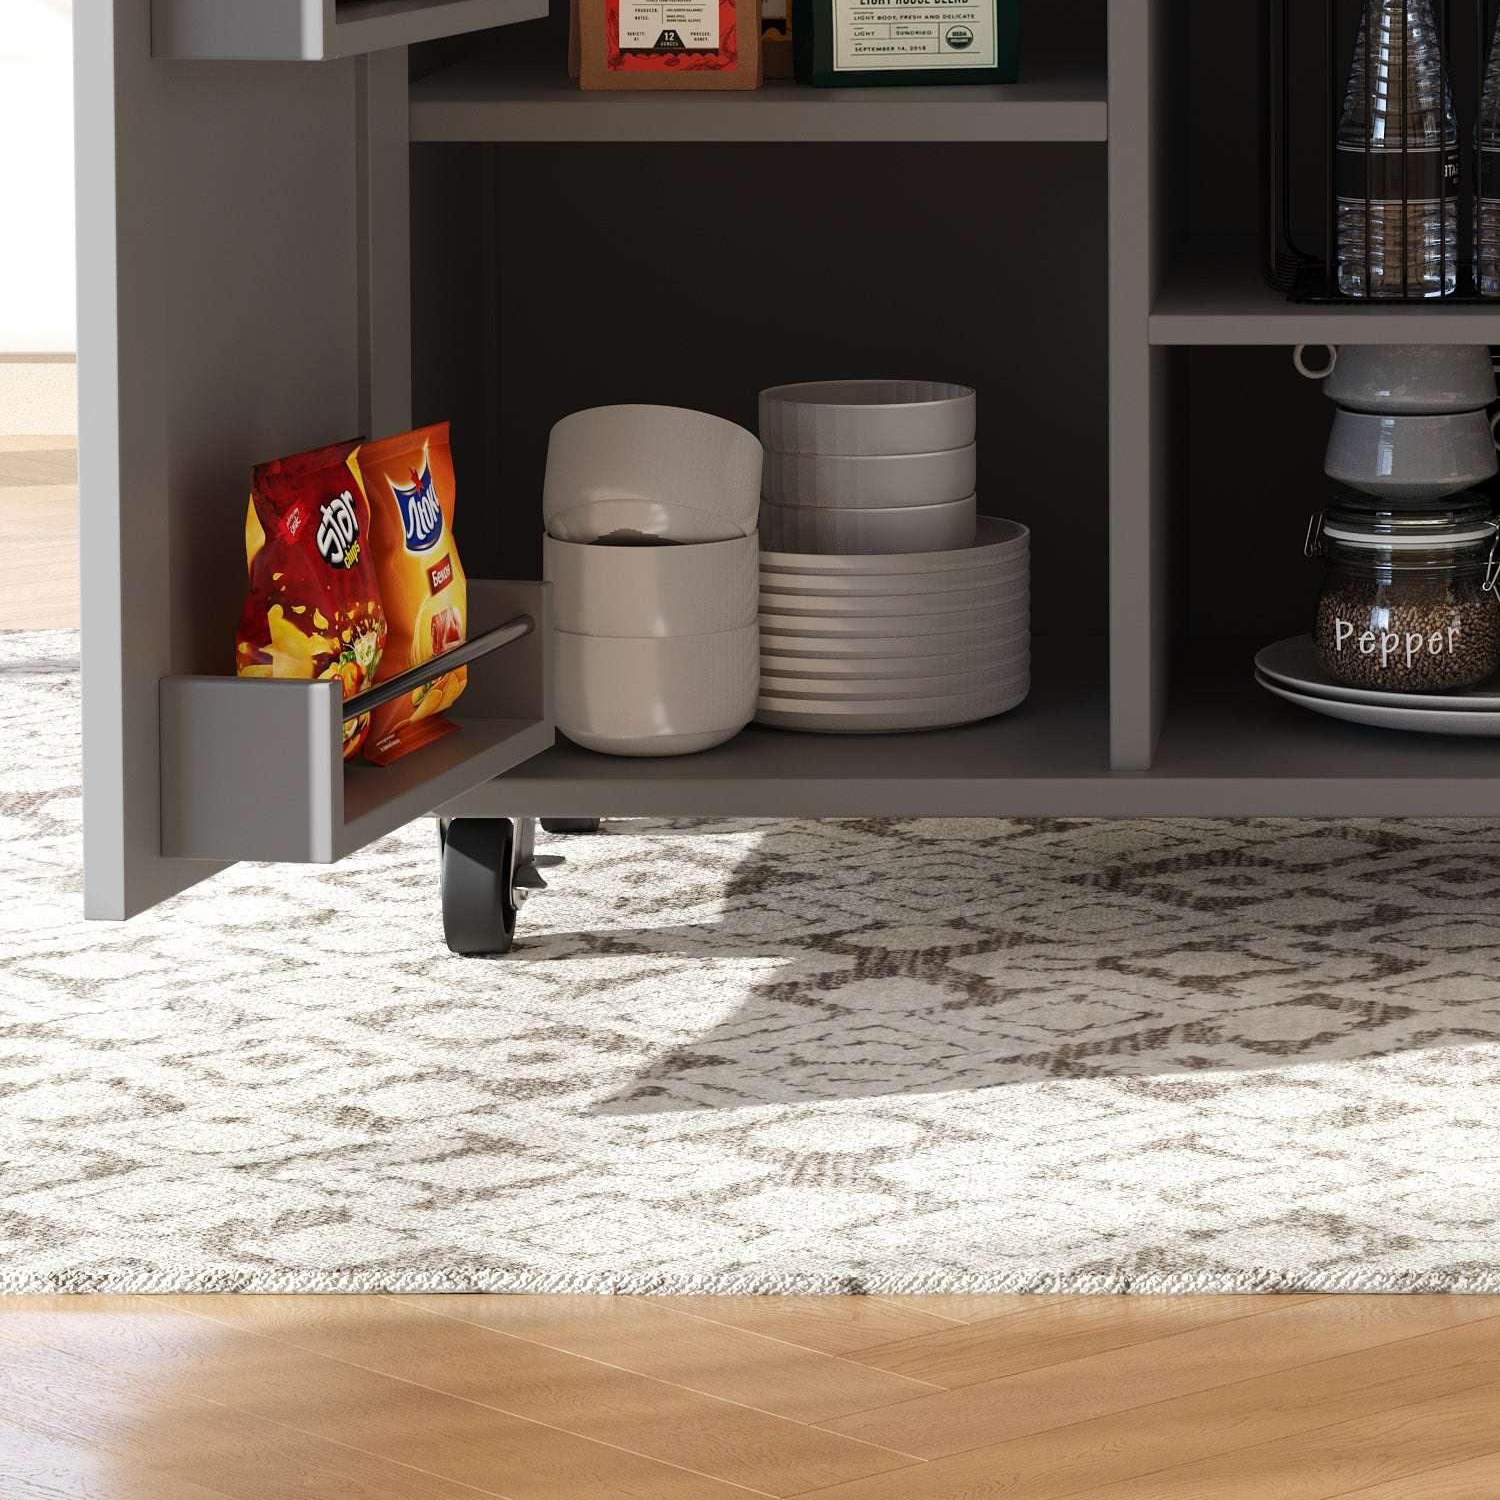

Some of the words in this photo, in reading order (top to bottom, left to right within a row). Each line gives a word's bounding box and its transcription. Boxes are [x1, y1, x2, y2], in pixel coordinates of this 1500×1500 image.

[664, 32, 675, 40] 12
[317, 490, 358, 564] Star
[344, 540, 360, 569] chips
[1334, 617, 1462, 669] Pepper
